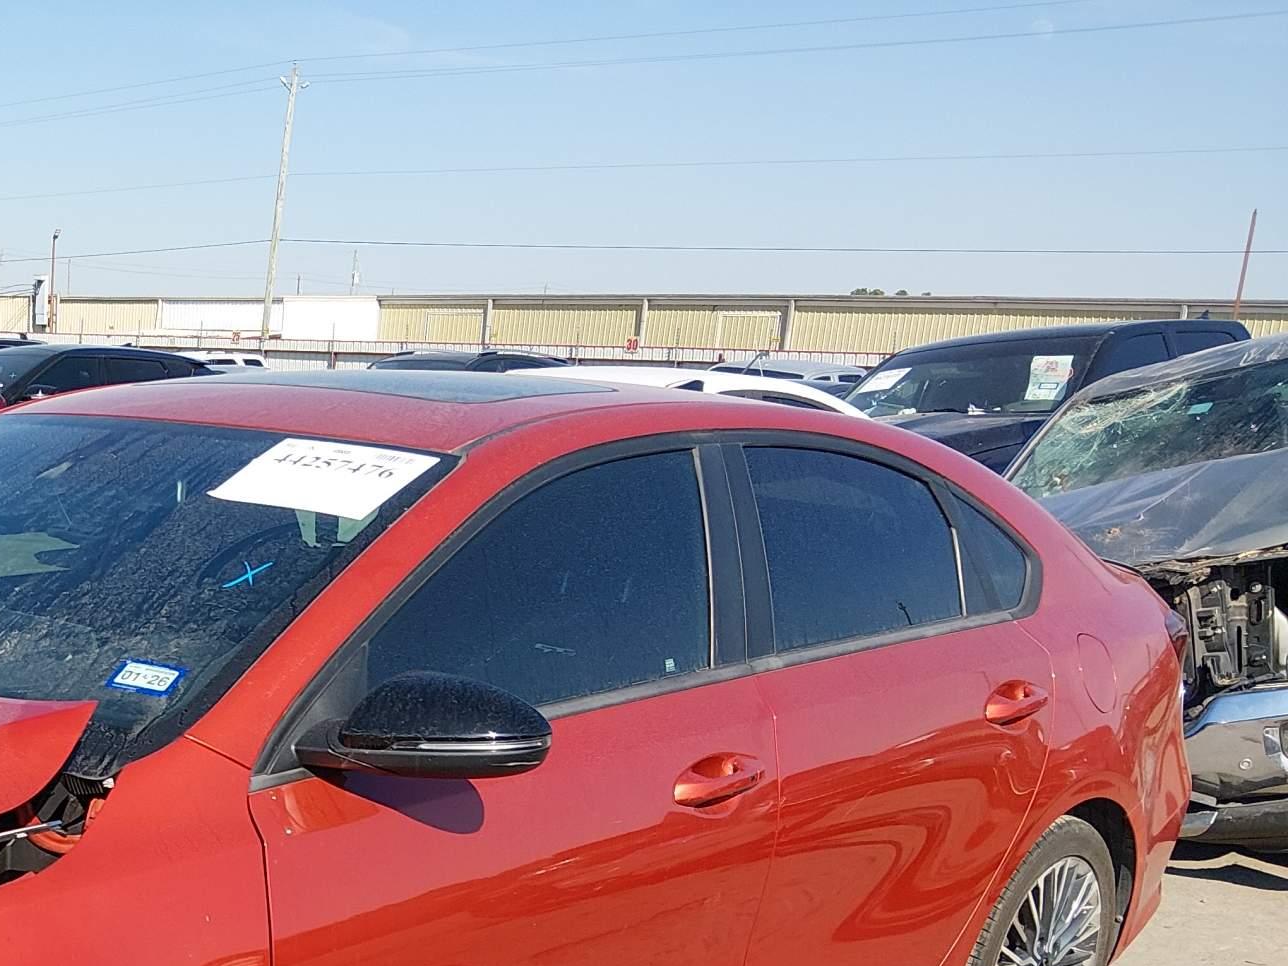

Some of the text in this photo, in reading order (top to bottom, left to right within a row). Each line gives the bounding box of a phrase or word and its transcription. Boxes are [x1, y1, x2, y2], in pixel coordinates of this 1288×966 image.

[626, 338, 639, 351] 30
[274, 453, 394, 479] 44257476
[121, 670, 142, 682] 01
[146, 674, 171, 687] 26
